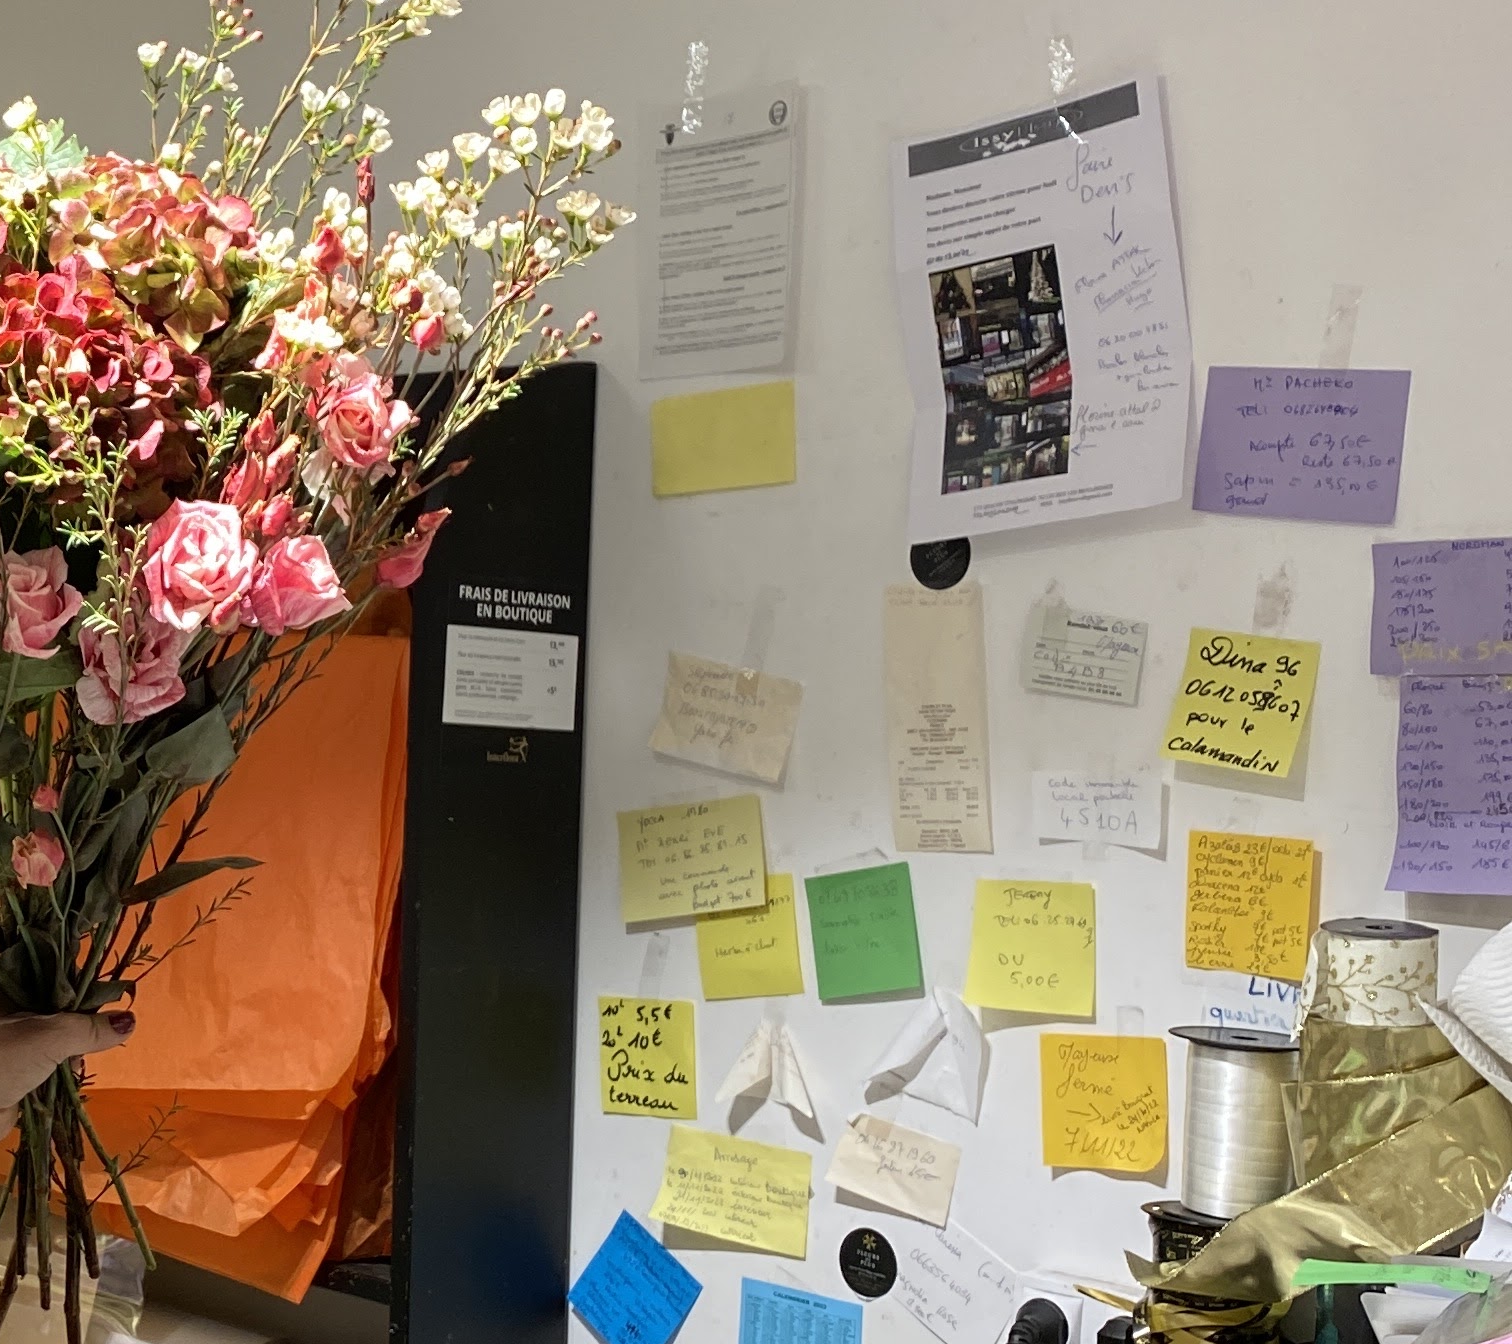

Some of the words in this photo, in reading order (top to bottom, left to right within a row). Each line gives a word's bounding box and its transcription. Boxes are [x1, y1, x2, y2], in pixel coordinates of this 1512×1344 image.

[459, 584, 492, 602] FRAIS
[493, 588, 509, 603] DE
[510, 590, 572, 610] LIVRAISON
[476, 603, 493, 618] EN
[494, 606, 553, 625] BOUTIQUE
[1200, 636, 1268, 674] Dina
[1185, 712, 1229, 729] pour
[1240, 717, 1256, 736] le
[1009, 971, 1060, 989] 5,00€
[636, 1003, 673, 1026] 5,5€
[627, 1027, 663, 1050] 10€
[607, 1048, 655, 1082] Prix
[663, 1062, 689, 1084] du
[609, 1085, 679, 1111] terreau
